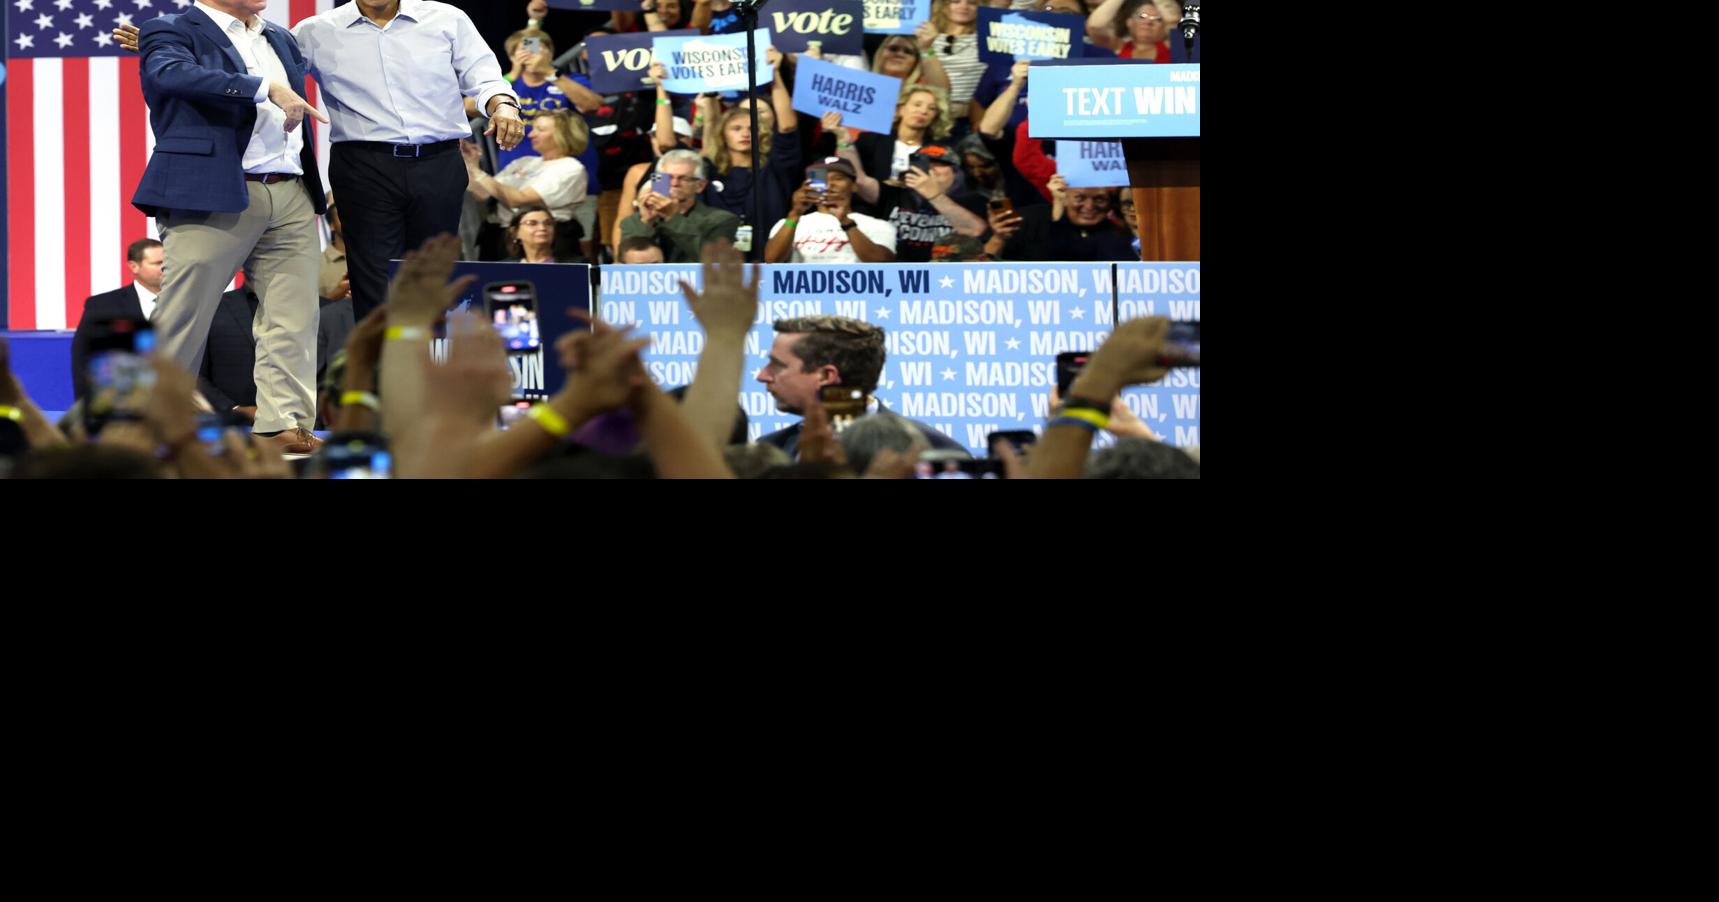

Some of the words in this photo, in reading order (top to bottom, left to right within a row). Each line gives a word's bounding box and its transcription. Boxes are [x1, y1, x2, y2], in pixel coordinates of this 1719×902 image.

[772, 8, 853, 35] vote
[989, 21, 1071, 43] WISCONSIN
[601, 48, 656, 72] vo
[986, 36, 1025, 55] VOTES
[1026, 40, 1072, 59] EARLY
[671, 65, 715, 80] VOTES
[811, 73, 876, 105] HARRIS
[1063, 87, 1126, 116] TEXT
[1134, 86, 1196, 115] WIN
[818, 94, 862, 114] WALZ
[1080, 141, 1120, 159] HAR
[1091, 160, 1127, 172] WA
[773, 269, 892, 298] MADISON,
[898, 269, 930, 293] WI
[963, 269, 1087, 298] MADISON,
[1092, 269, 1113, 293] W
[648, 300, 679, 325] WI
[900, 300, 1022, 328] MADISON,
[1028, 300, 1060, 325] WI
[963, 331, 996, 356] WI
[900, 361, 932, 386] WI
[902, 391, 1025, 421] MADISON,
